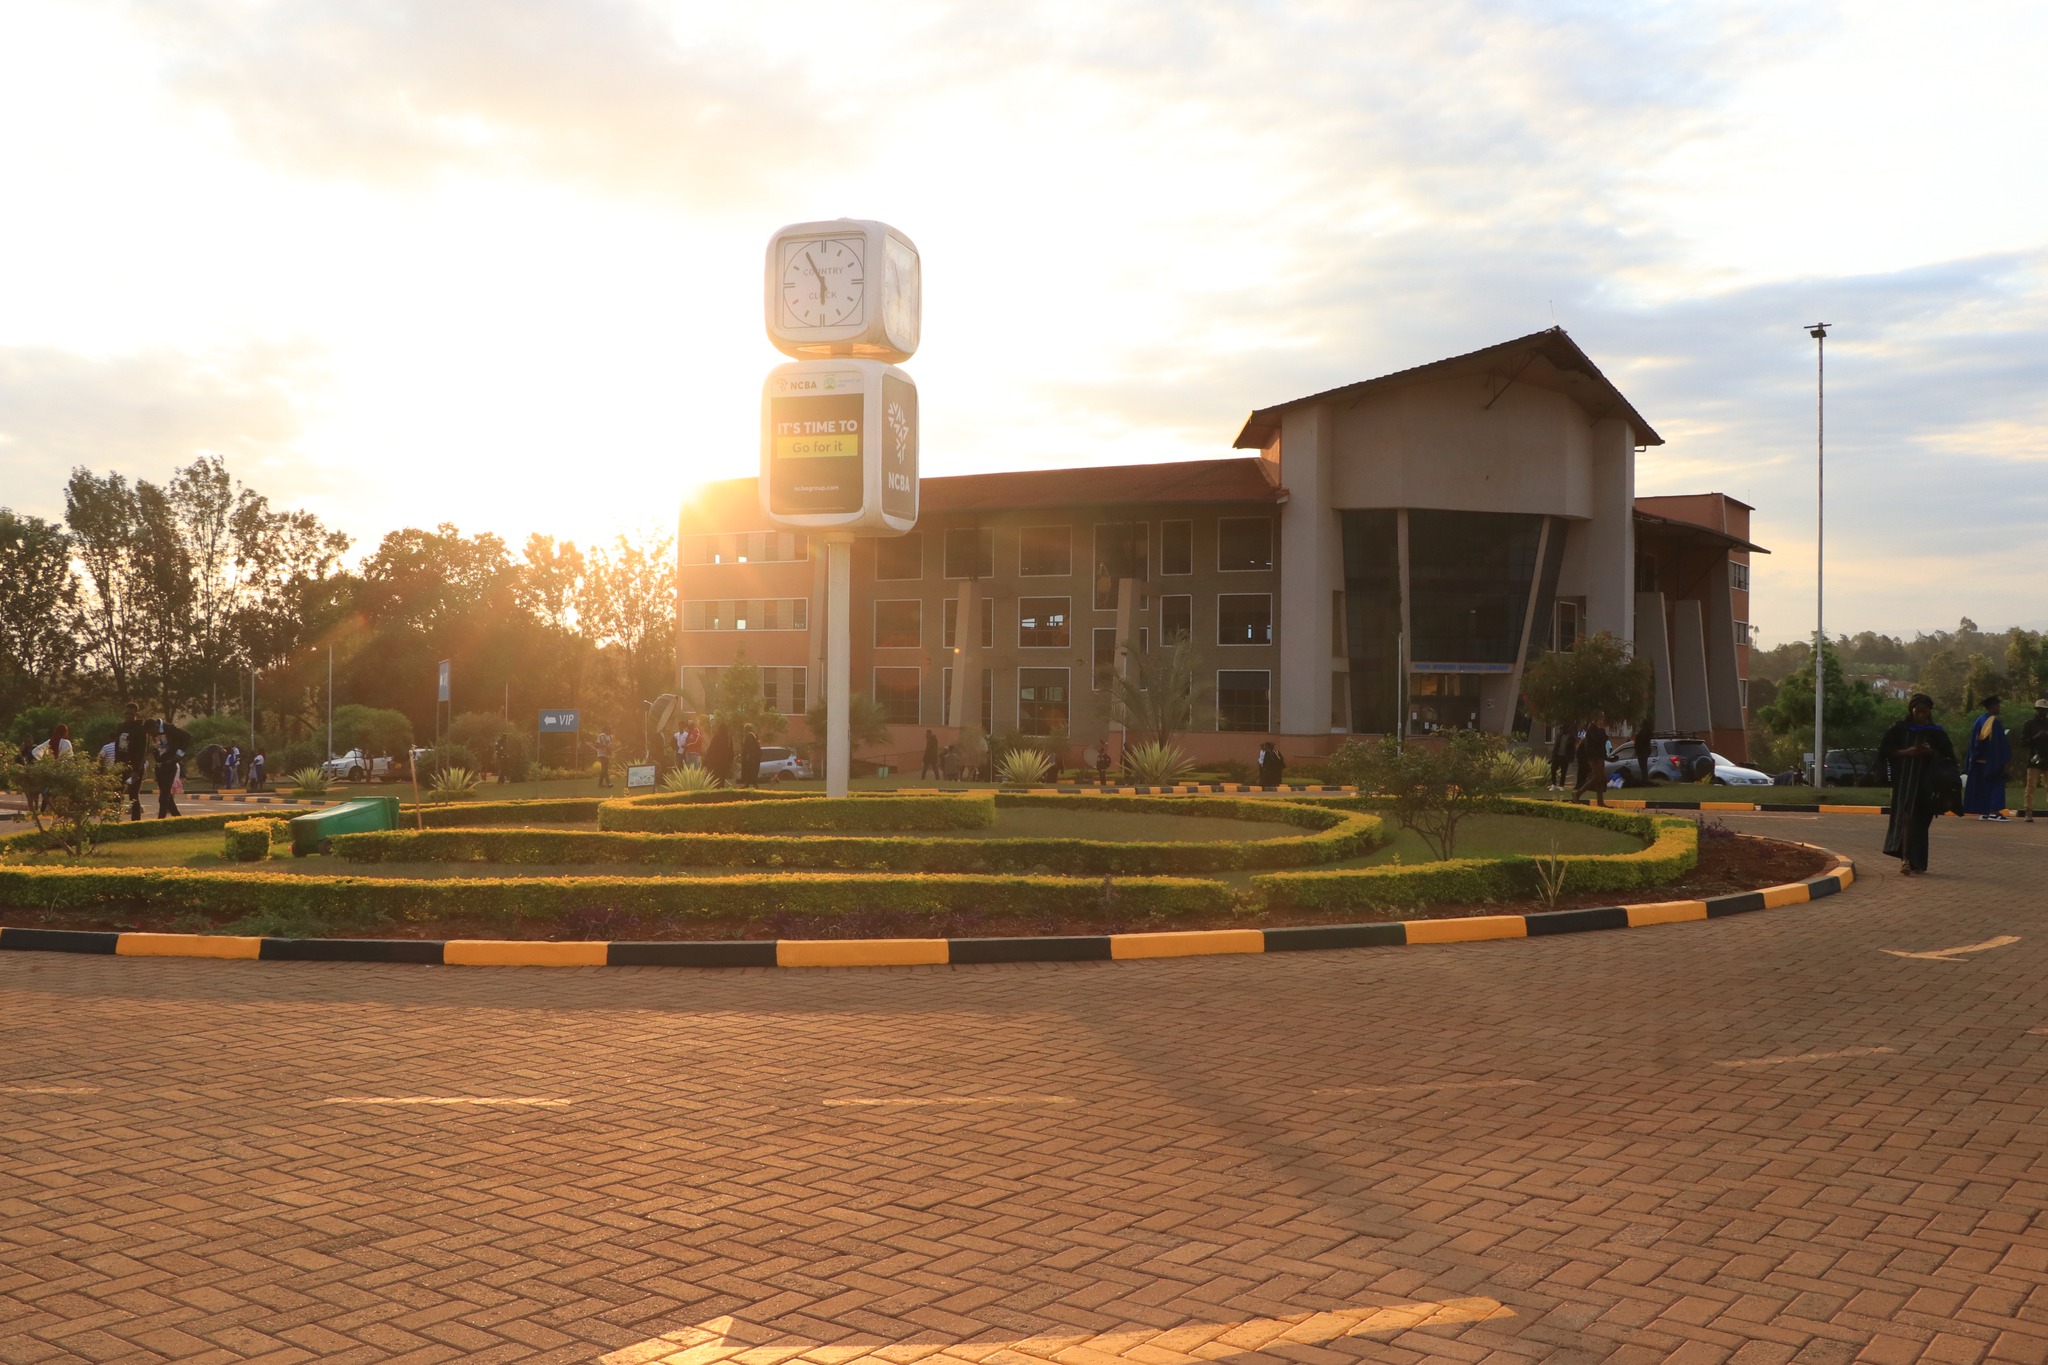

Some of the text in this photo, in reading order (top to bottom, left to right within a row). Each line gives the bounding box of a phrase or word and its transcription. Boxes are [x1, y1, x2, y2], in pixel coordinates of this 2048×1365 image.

[808, 291, 837, 299] CLCK
[790, 380, 817, 390] NCBA
[778, 420, 858, 434] IT'S TIME TO
[792, 440, 843, 453] Go for it
[888, 472, 910, 492] NCBA
[559, 714, 575, 725] VIP
